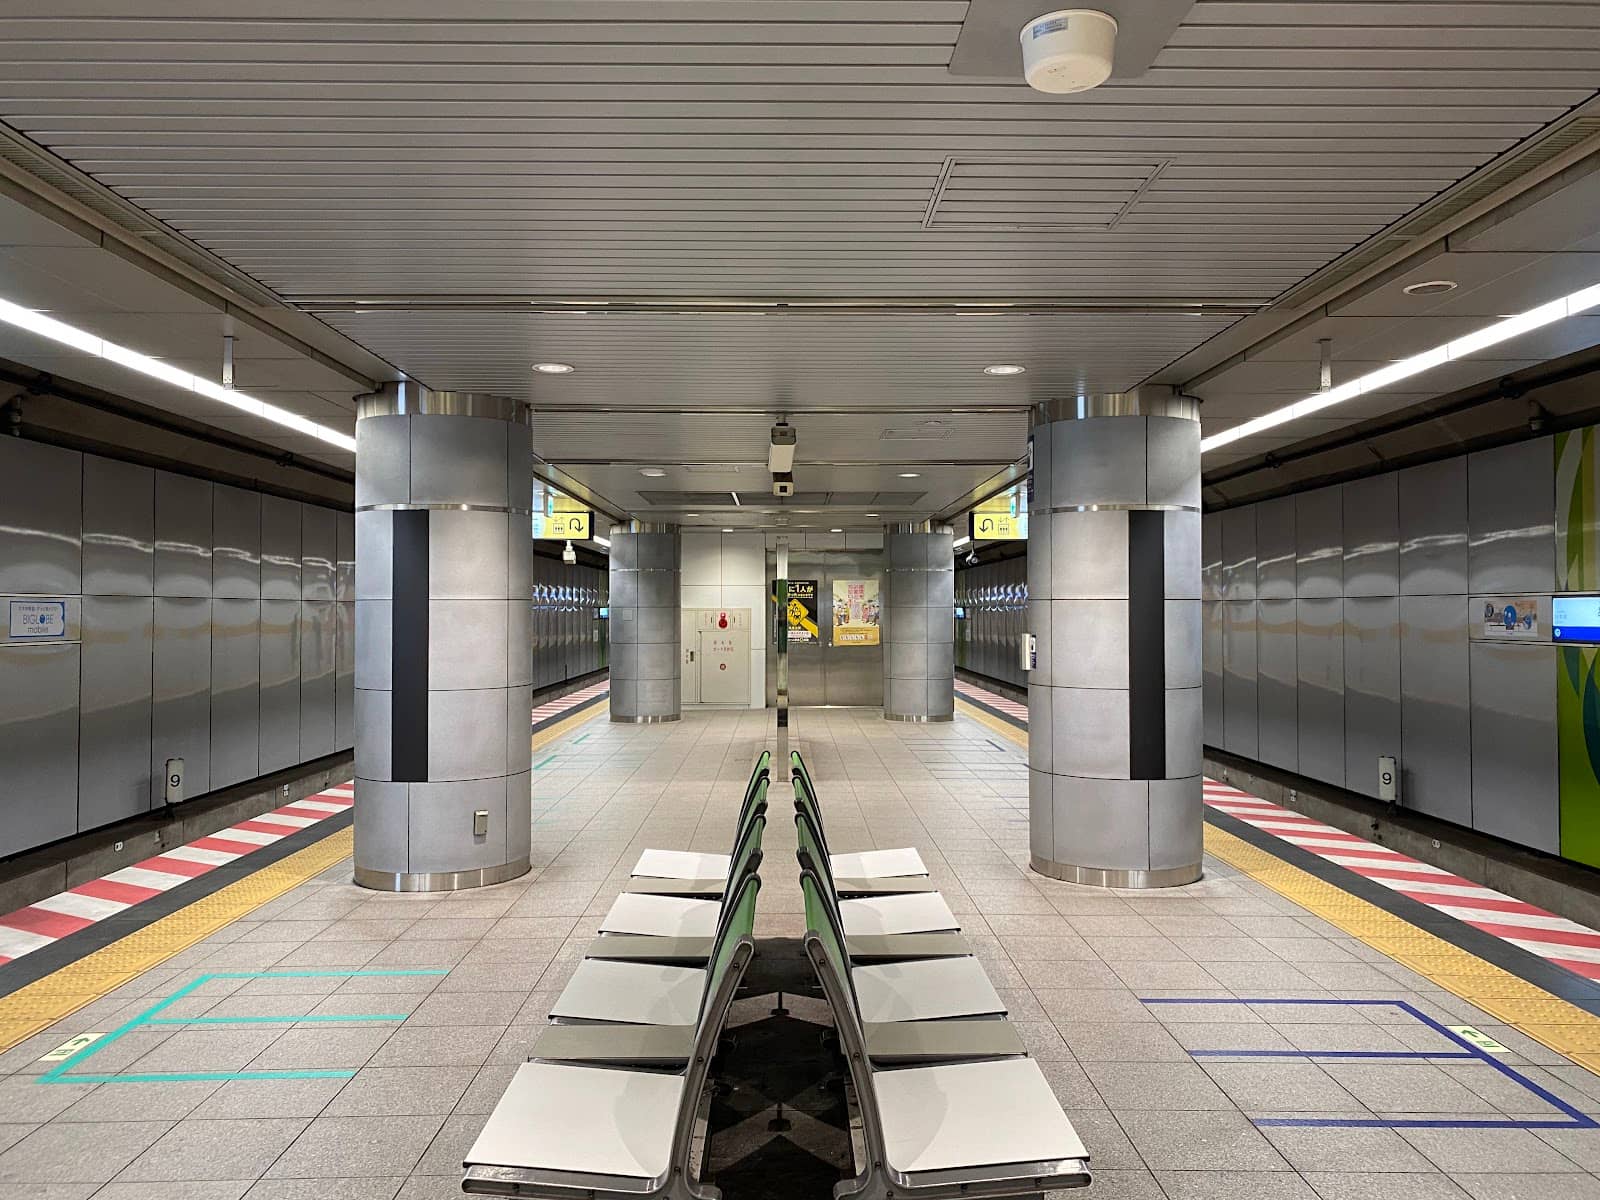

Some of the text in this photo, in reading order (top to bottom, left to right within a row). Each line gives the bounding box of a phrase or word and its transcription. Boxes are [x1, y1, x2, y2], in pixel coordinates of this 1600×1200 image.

[23, 614, 54, 625] BIGLOBE
[170, 774, 180, 788] 9
[1382, 772, 1392, 785] 9
